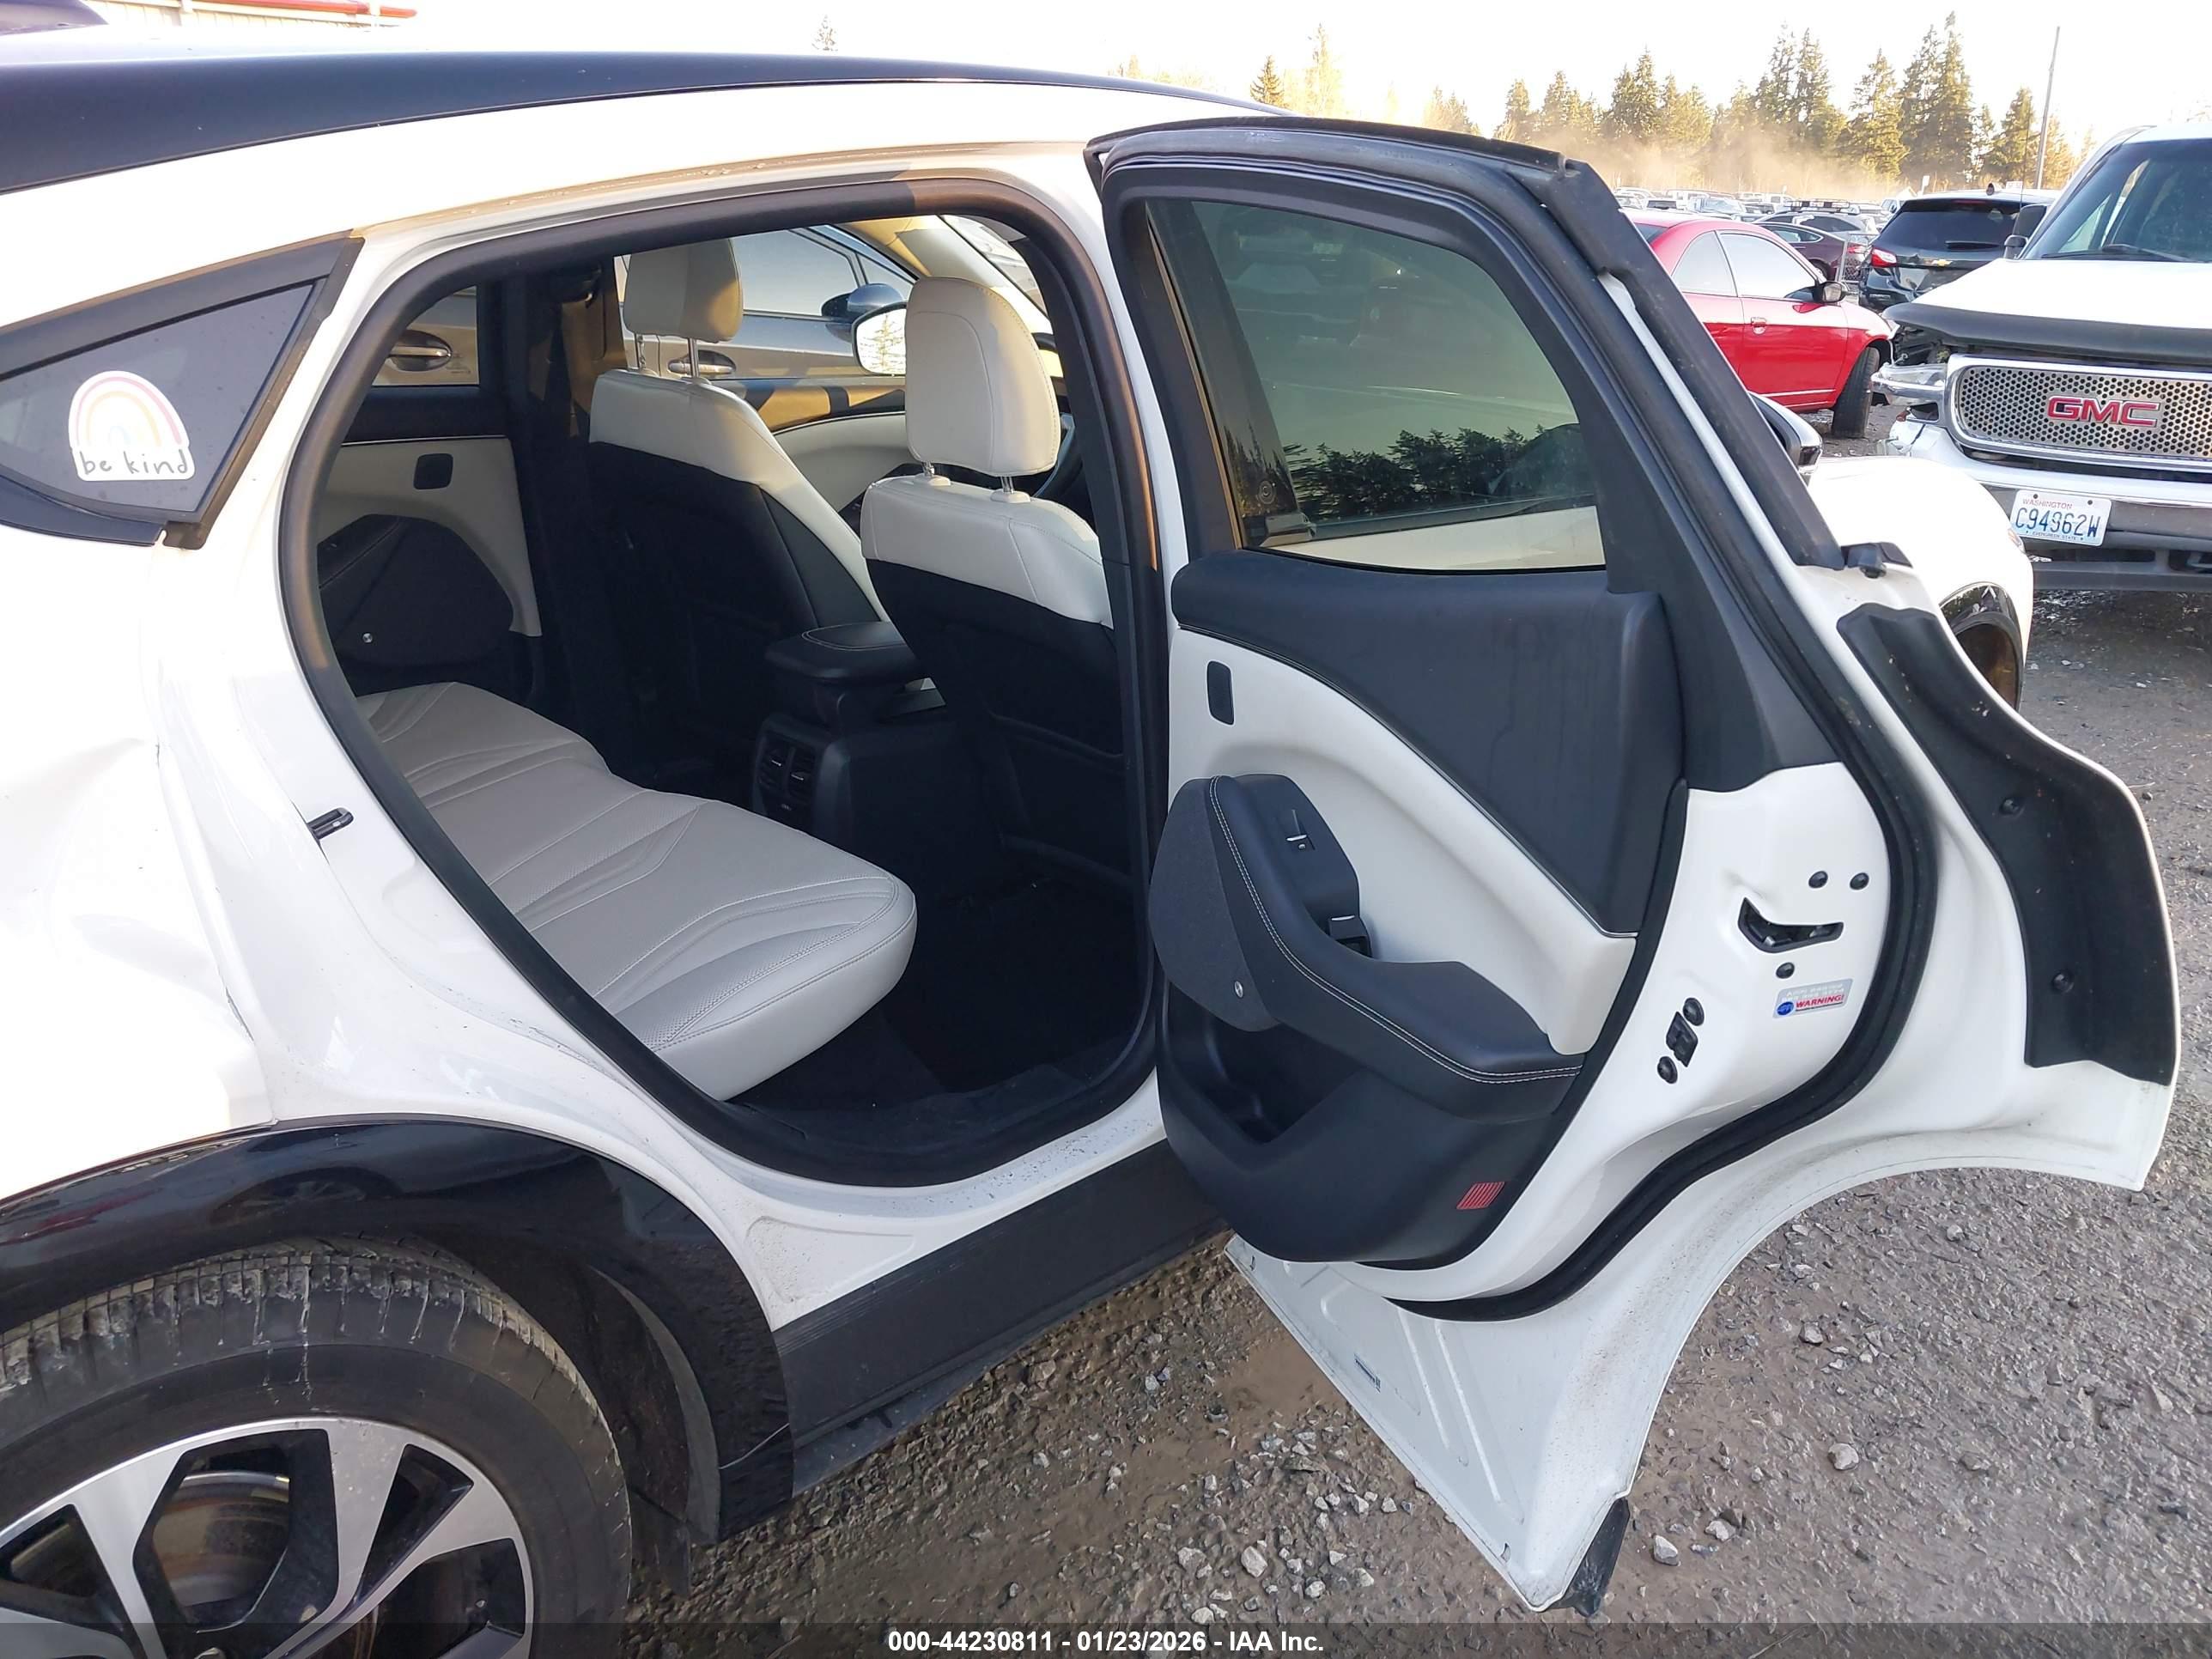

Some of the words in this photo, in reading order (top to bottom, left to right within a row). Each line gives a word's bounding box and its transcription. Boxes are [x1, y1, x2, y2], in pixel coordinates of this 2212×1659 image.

[2047, 395, 2160, 427] GMC
[80, 450, 112, 474] be
[123, 449, 188, 474] kind
[2023, 499, 2073, 510] WASHINGTON
[1796, 994, 1844, 1008] WARNING!
